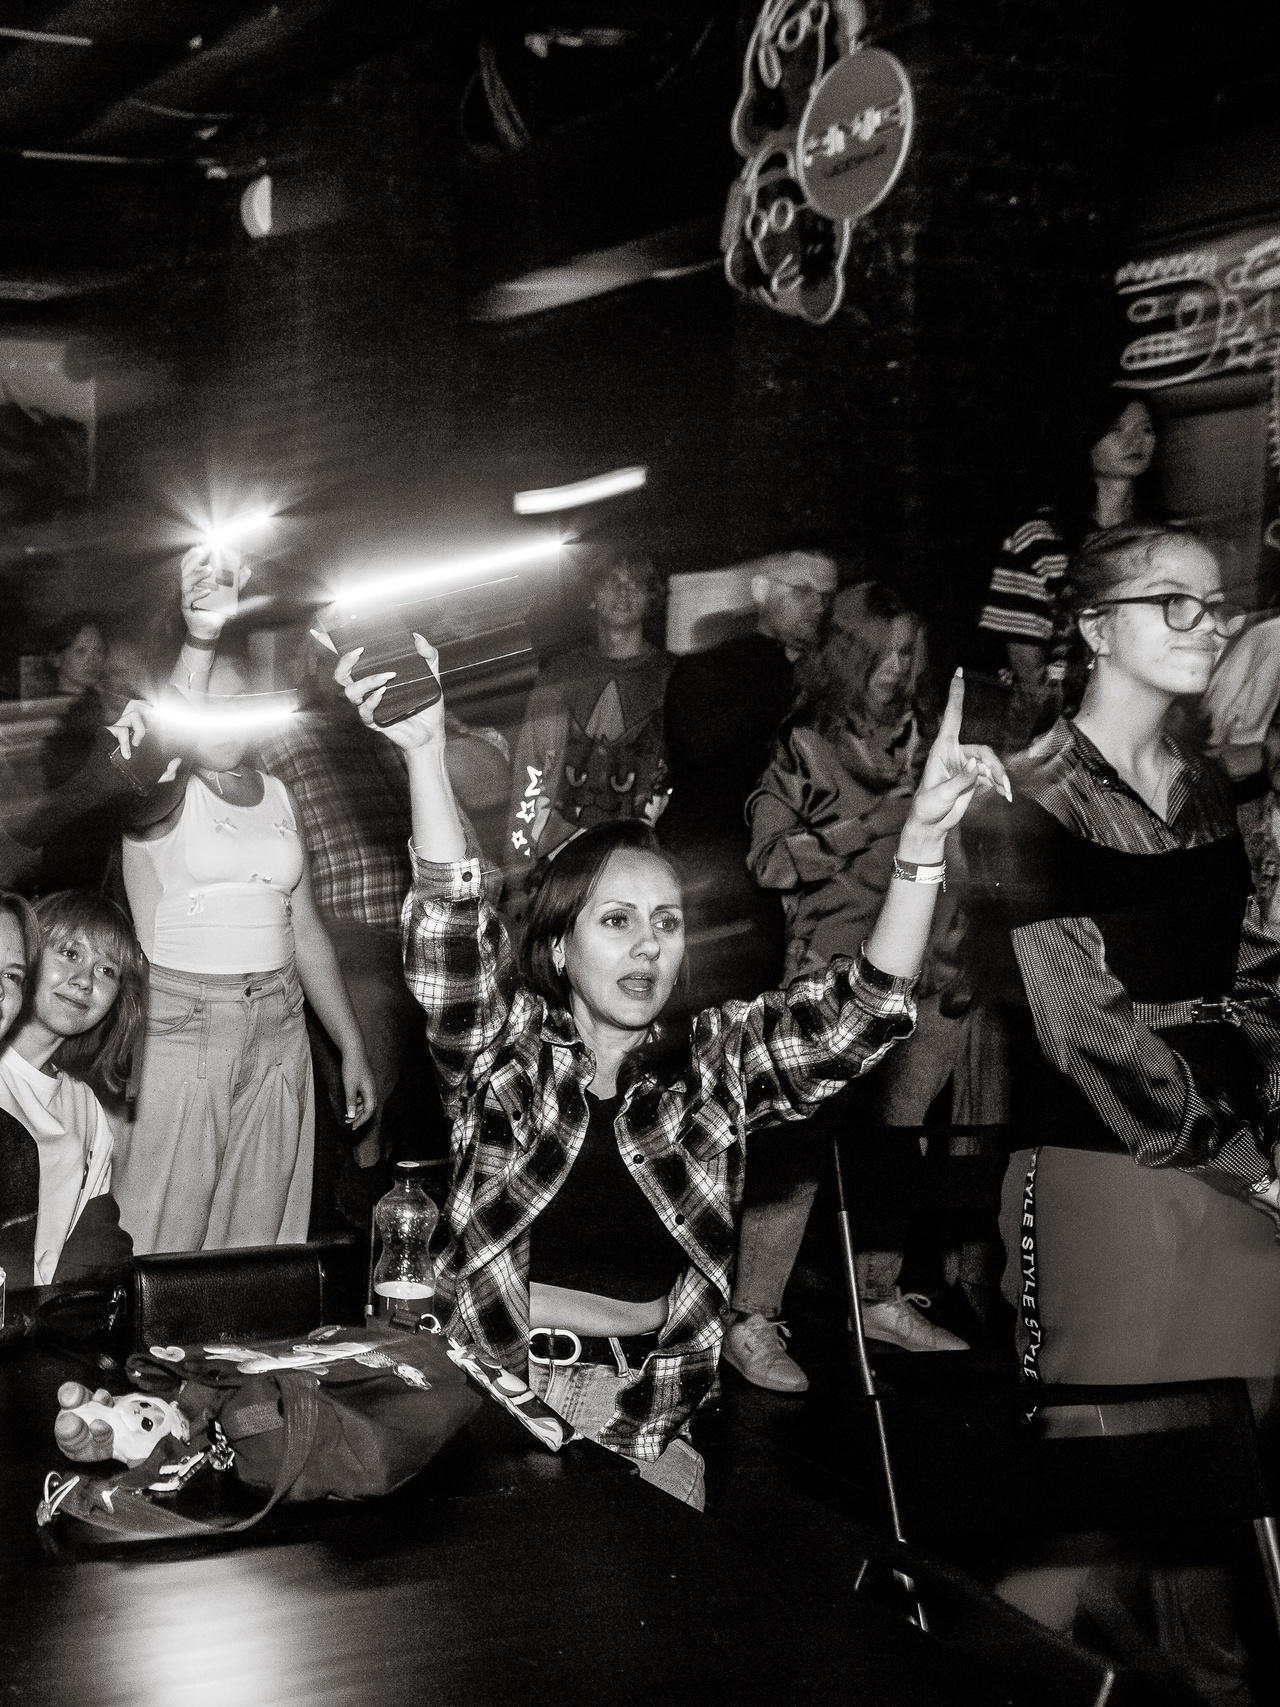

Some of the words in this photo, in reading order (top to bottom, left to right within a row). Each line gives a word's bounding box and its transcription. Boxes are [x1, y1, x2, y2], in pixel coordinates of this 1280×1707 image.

[1022, 1156, 1037, 1228] TYLE
[1021, 1236, 1036, 1308] STYLE
[1022, 1317, 1042, 1380] STYLE
